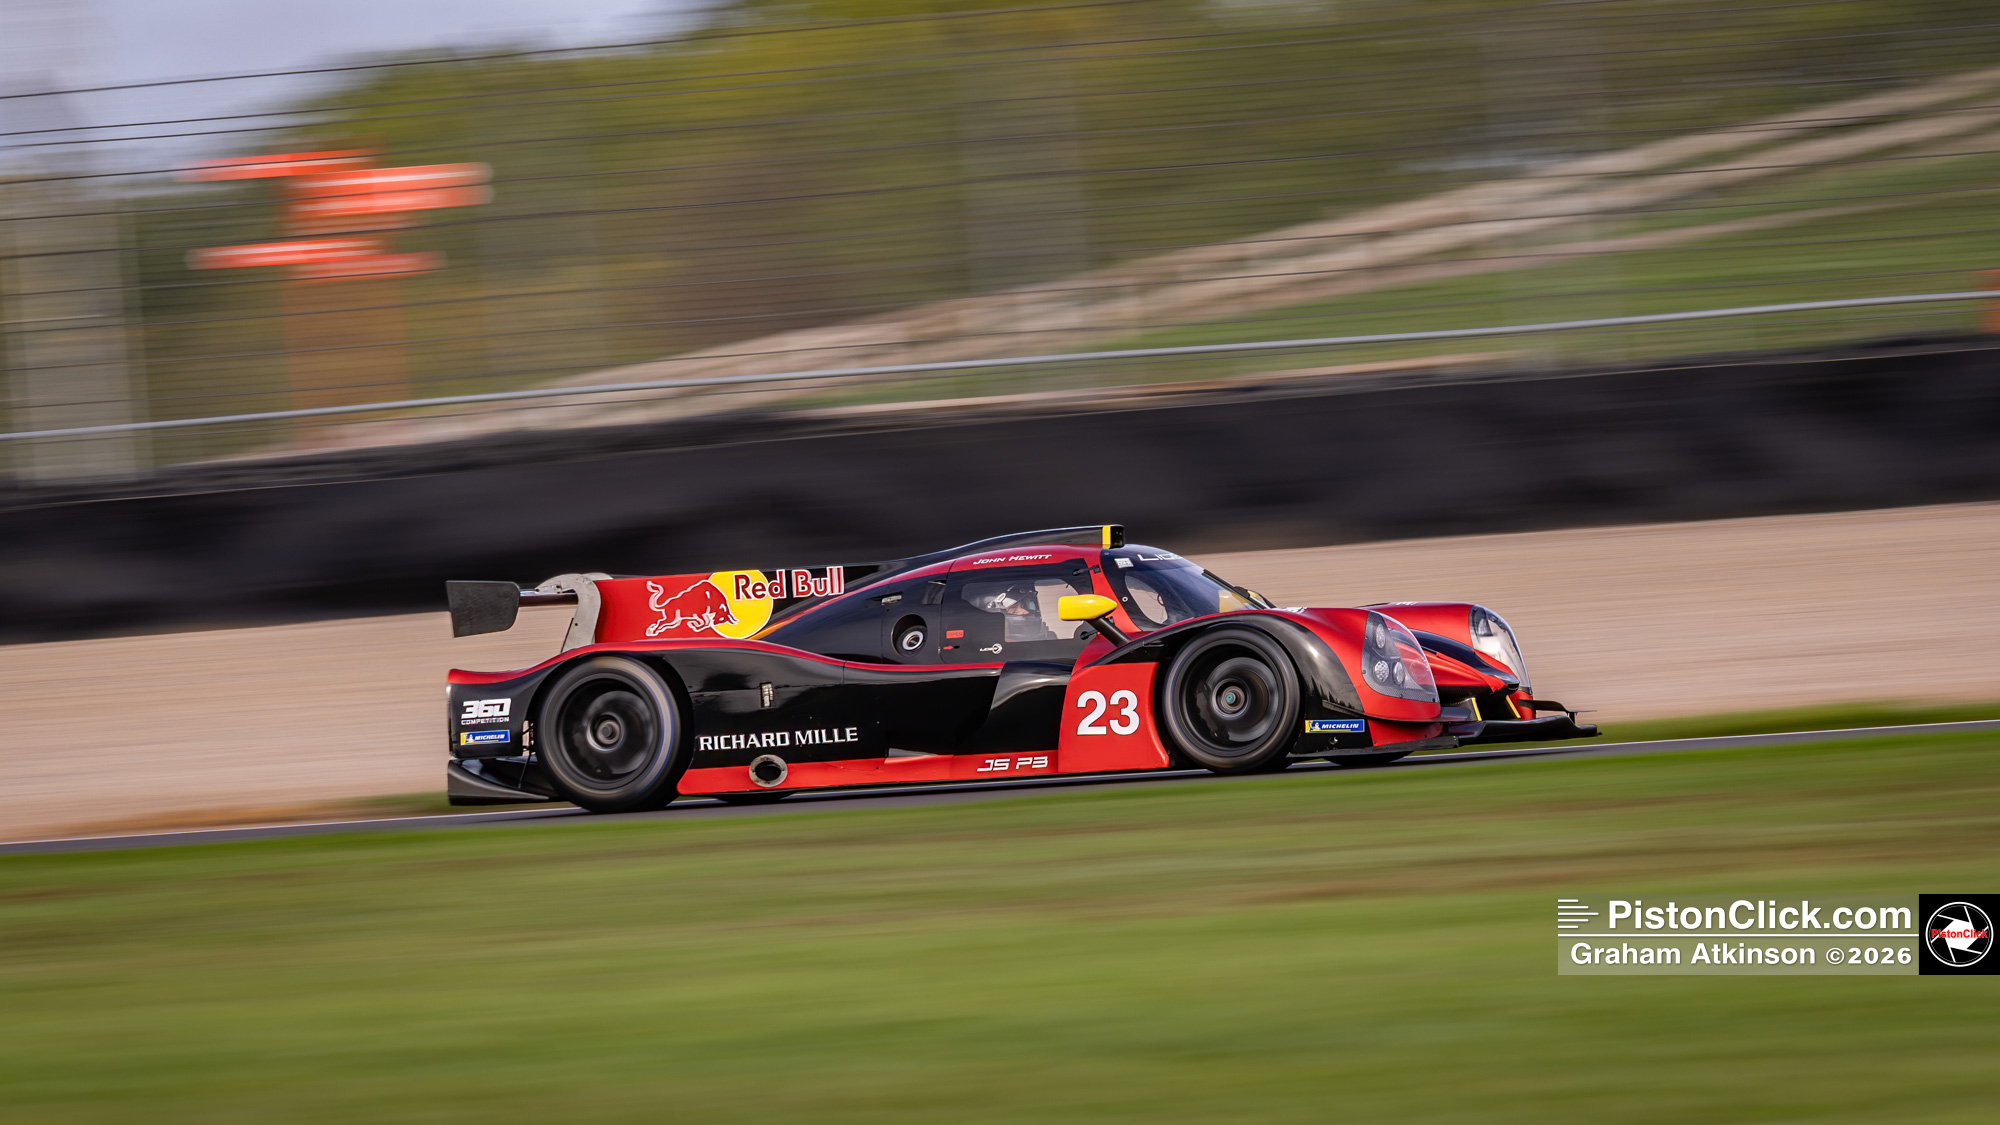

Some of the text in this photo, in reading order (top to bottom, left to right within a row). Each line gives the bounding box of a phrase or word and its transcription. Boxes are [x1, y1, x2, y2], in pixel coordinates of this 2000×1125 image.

[973, 557, 1006, 565] JOHN
[733, 565, 845, 601] Red Bull
[461, 698, 511, 719] 360
[1076, 689, 1140, 736] 23
[461, 717, 510, 726] COMPETITION
[700, 727, 858, 751] RICHARD MILLE
[976, 756, 1049, 772] JS P3
